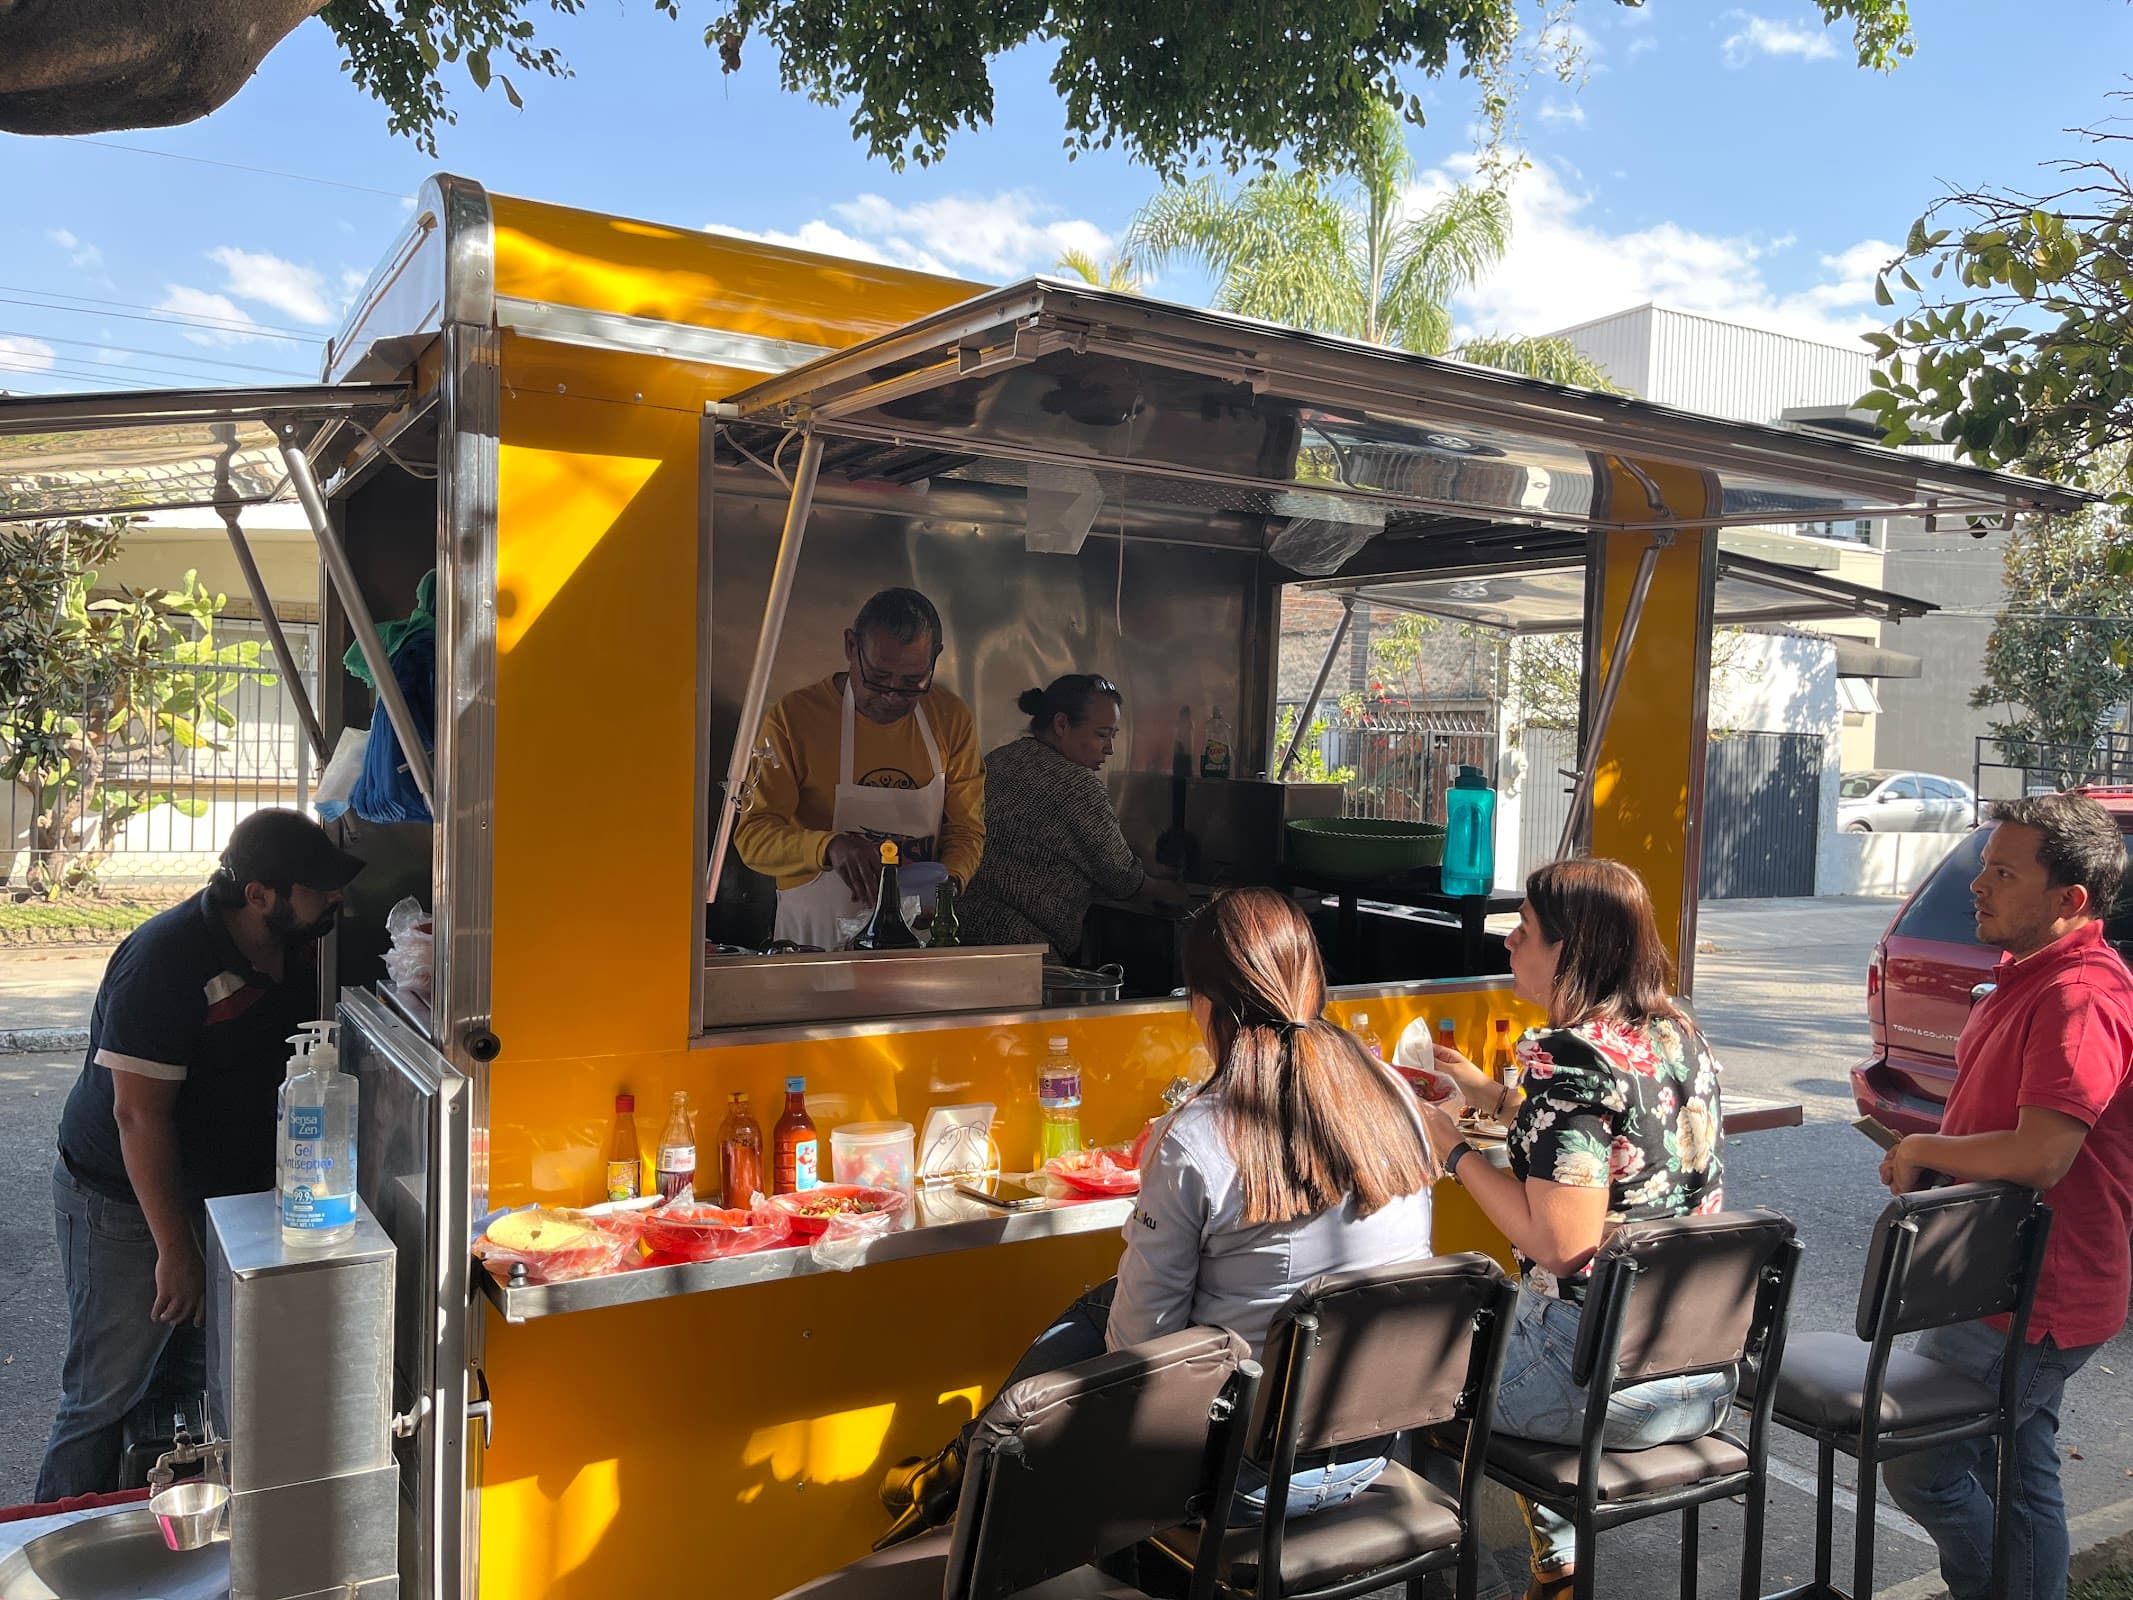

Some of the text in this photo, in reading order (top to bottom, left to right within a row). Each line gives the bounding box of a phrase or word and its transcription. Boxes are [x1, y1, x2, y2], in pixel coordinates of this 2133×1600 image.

[1892, 1024, 1917, 1034] TOWN
[290, 1112, 317, 1124] Sensa
[298, 1124, 318, 1135] Zen
[294, 1143, 314, 1157] Gel
